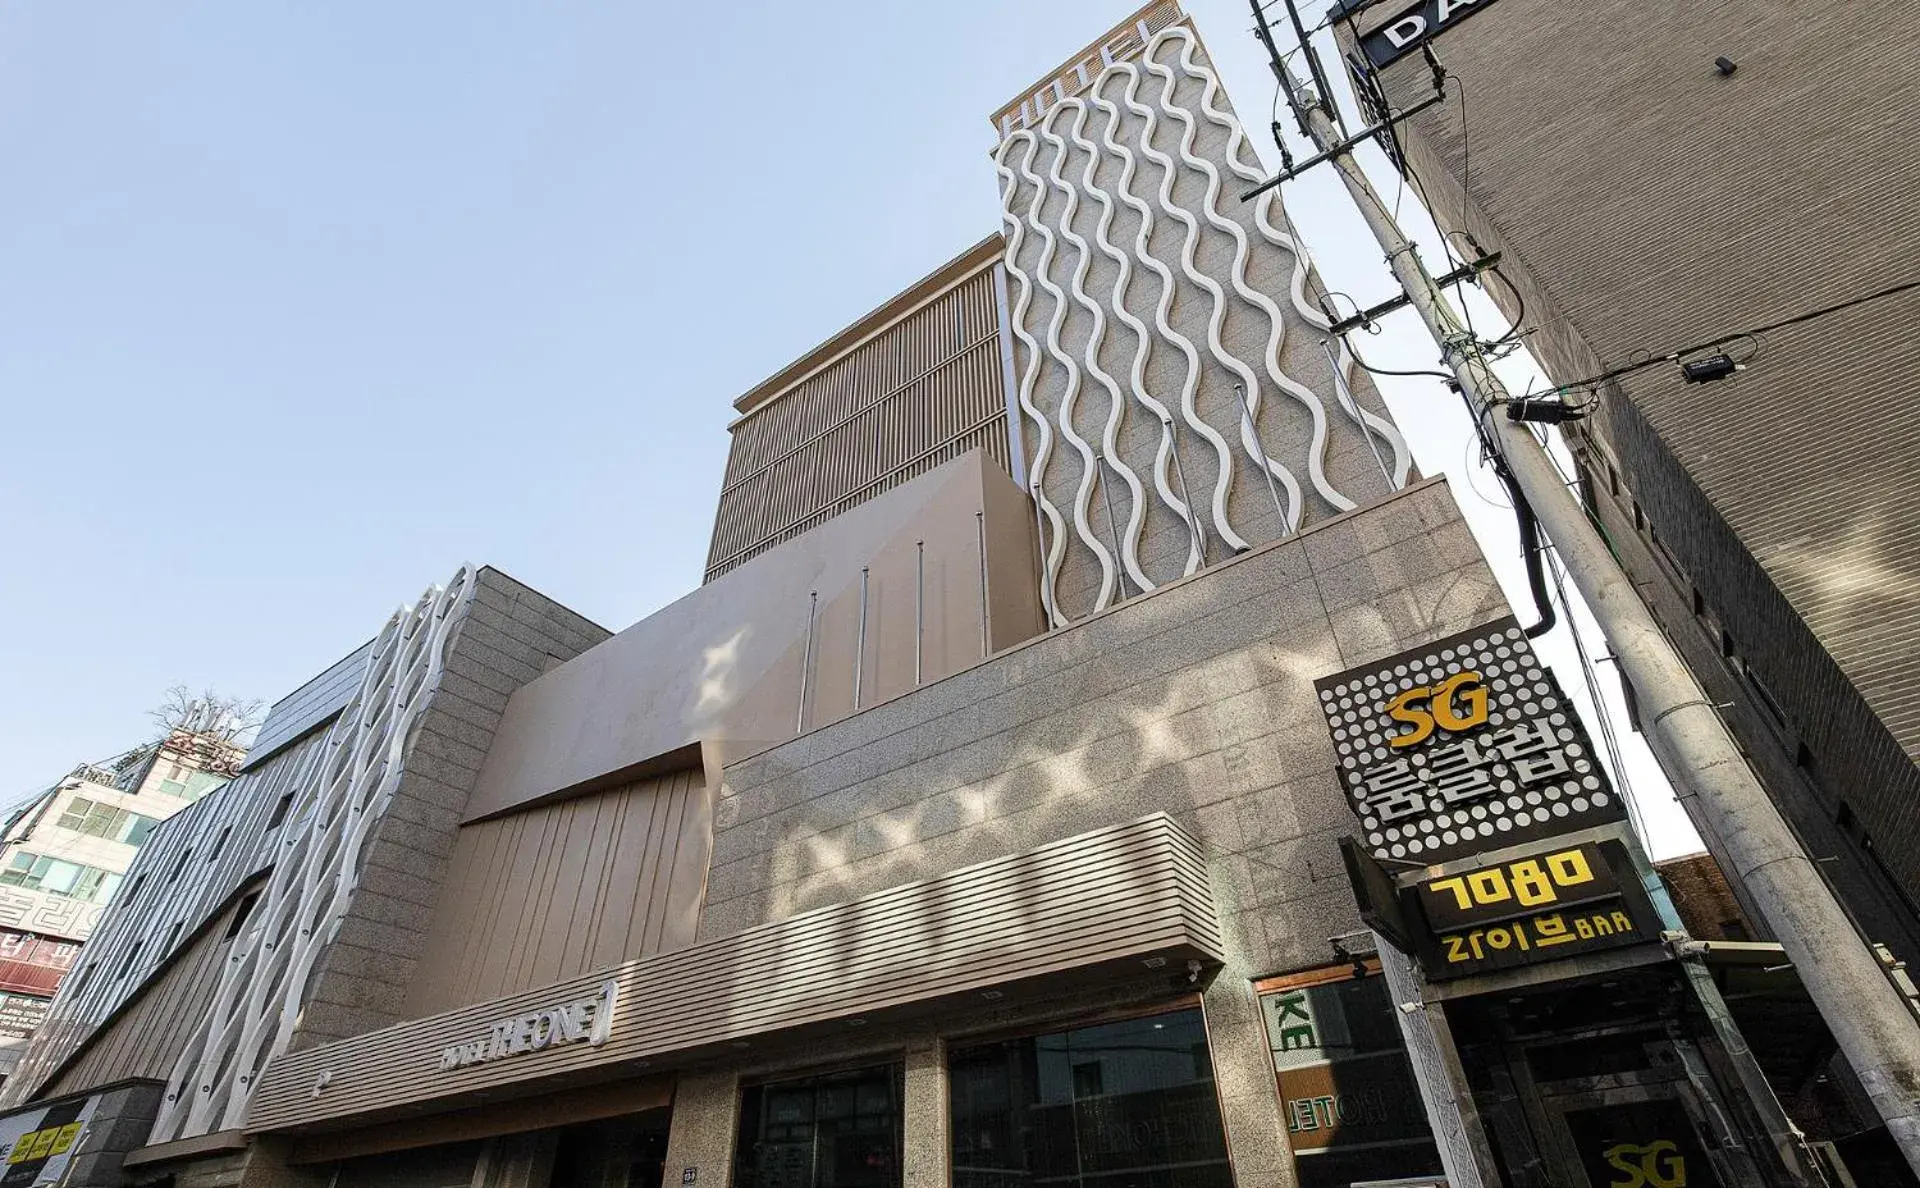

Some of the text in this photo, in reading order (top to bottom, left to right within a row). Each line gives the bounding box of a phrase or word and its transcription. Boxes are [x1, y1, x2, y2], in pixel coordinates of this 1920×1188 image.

[1384, 671, 1488, 747] SG
[1364, 717, 1572, 825] 룸클럽
[1429, 849, 1595, 910] 7080
[1603, 1140, 1687, 1188] SG
